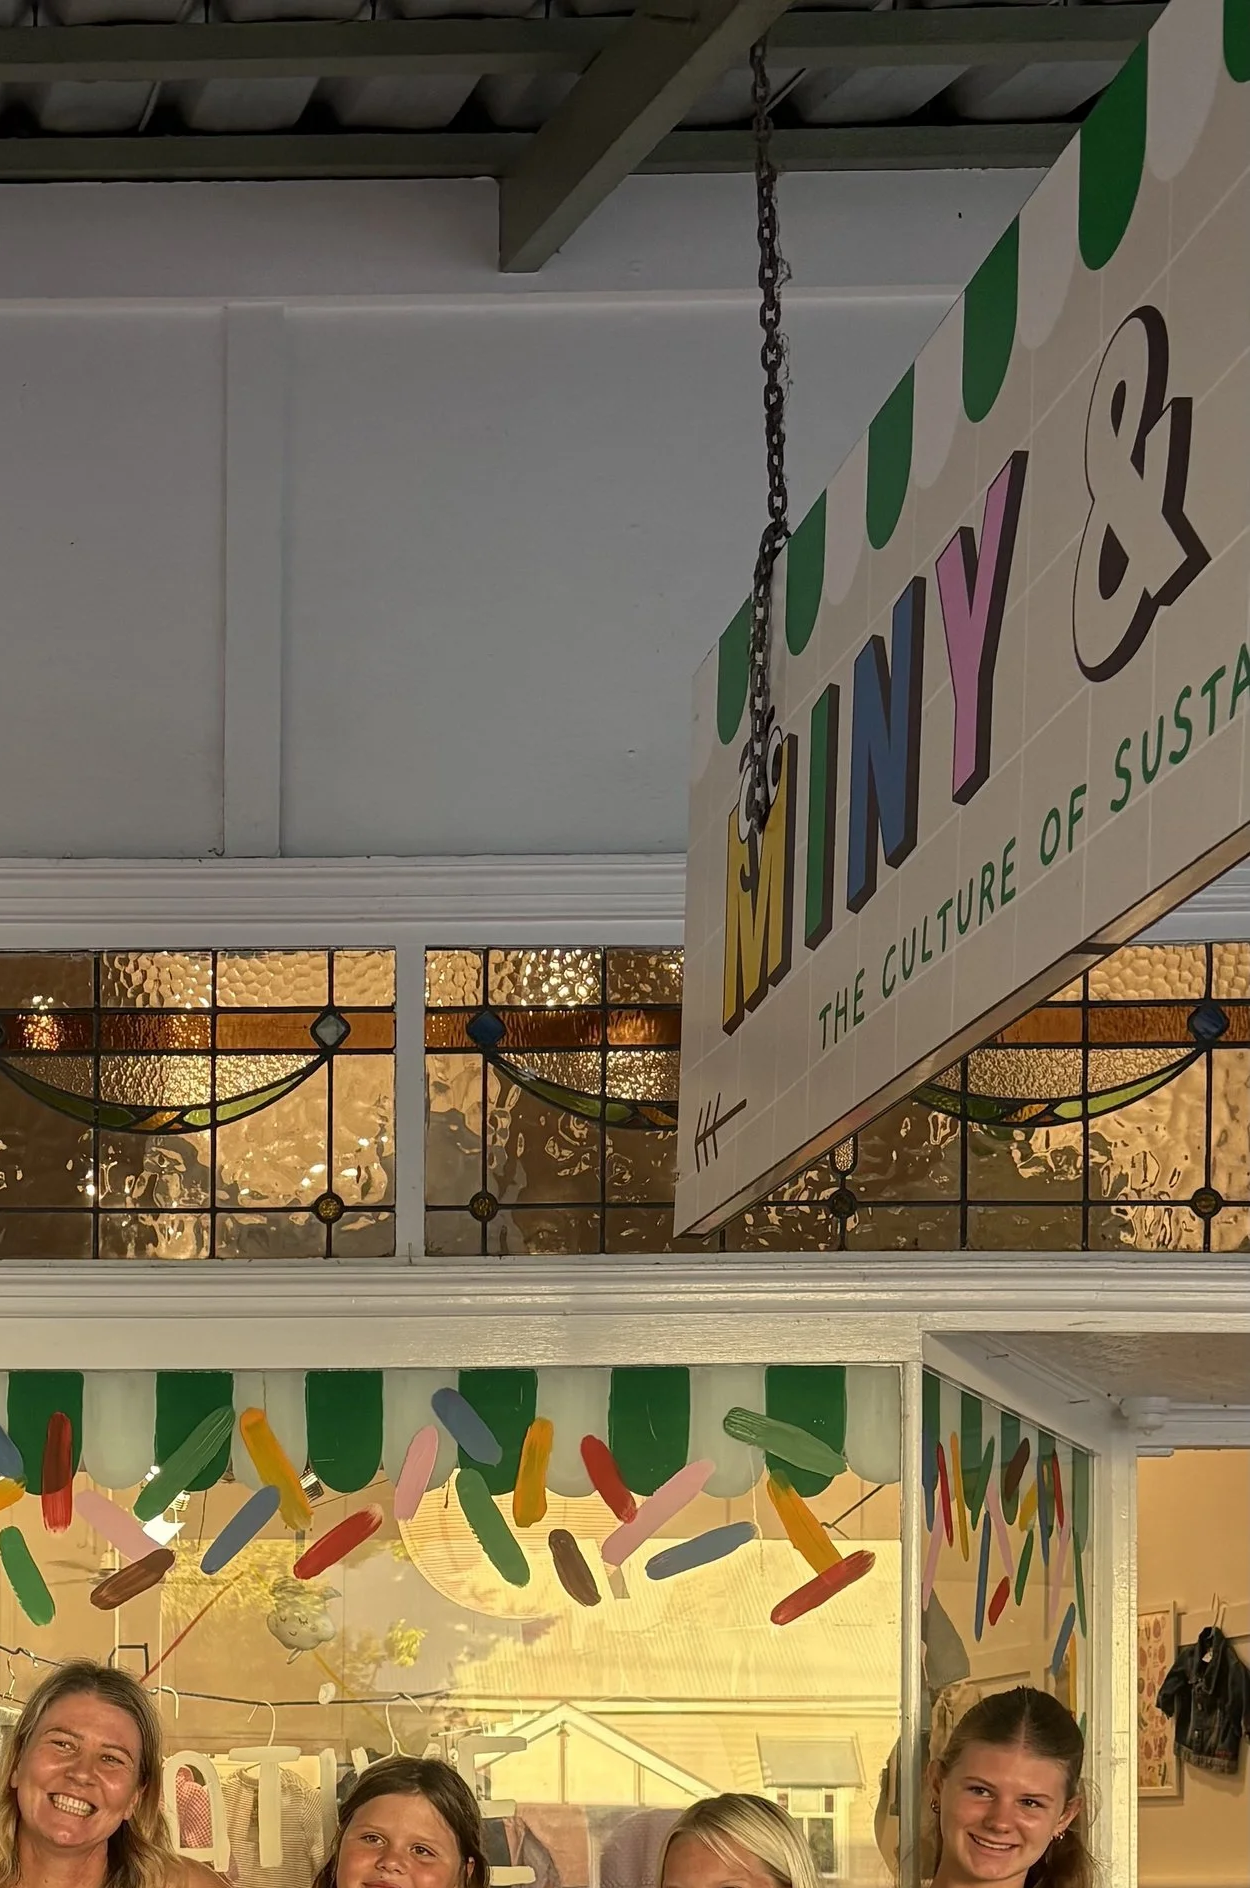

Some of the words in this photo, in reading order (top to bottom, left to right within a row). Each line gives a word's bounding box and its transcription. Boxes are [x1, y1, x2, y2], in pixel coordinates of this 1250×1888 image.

[721, 450, 1028, 1036] MINY
[1073, 304, 1211, 683] &
[818, 978, 865, 1052] THE
[881, 837, 1018, 1002] CULTURE
[1040, 784, 1088, 867] OF
